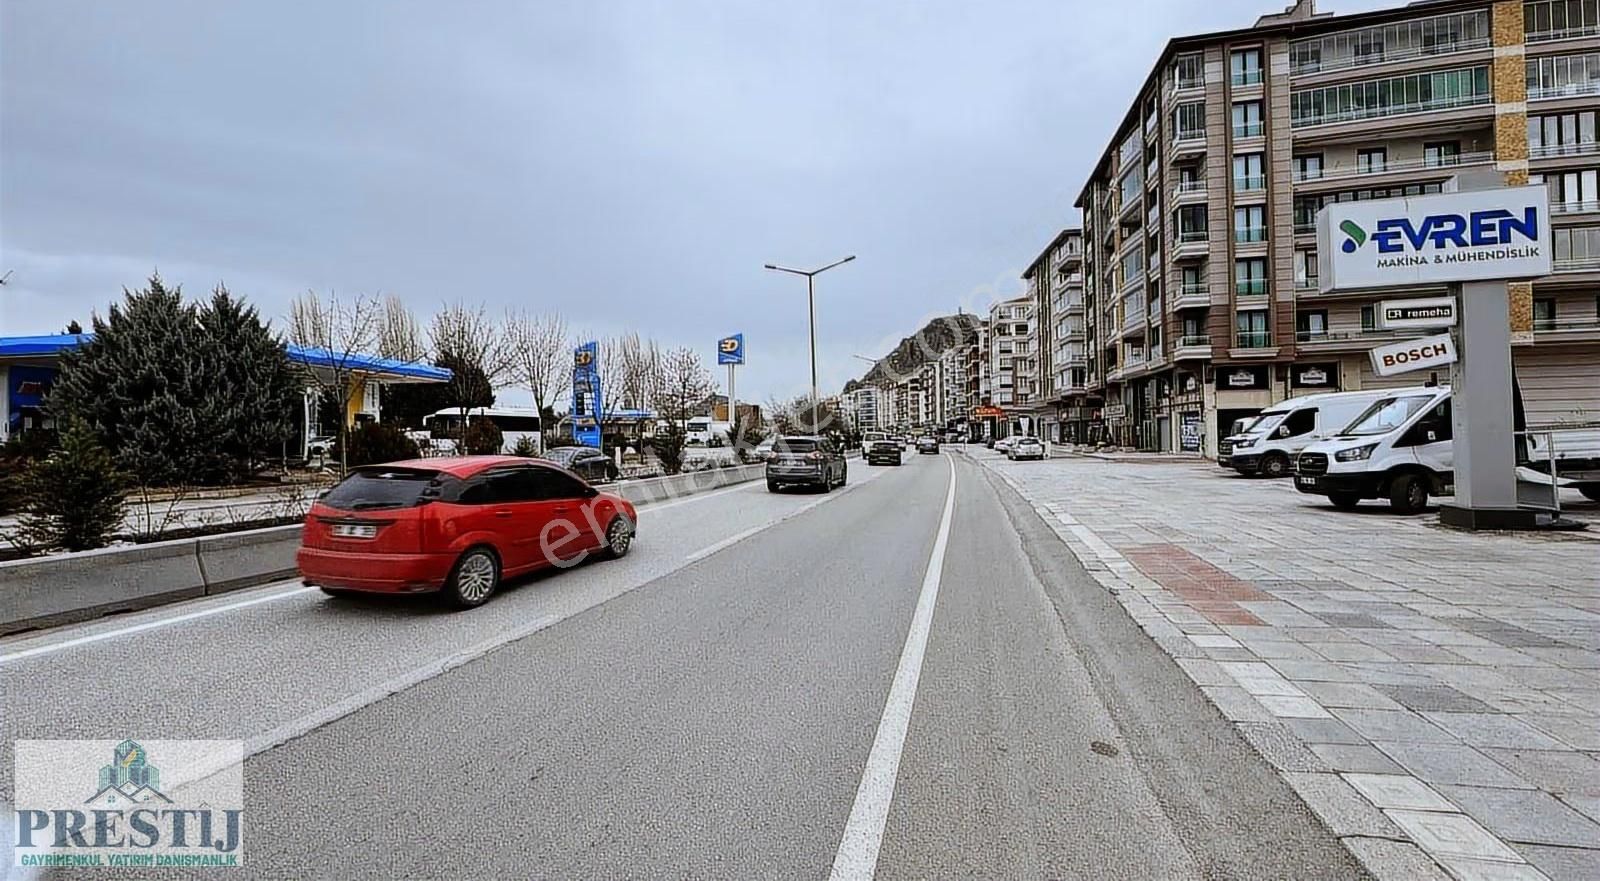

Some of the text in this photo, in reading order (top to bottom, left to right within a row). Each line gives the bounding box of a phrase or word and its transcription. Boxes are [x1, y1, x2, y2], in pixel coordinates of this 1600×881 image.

[1370, 207, 1538, 254] EVREN
[1377, 247, 1540, 268] MAKİNA & MÜHENDİSLİK
[1407, 308, 1451, 318] remeha
[1383, 343, 1447, 367] BOSCH
